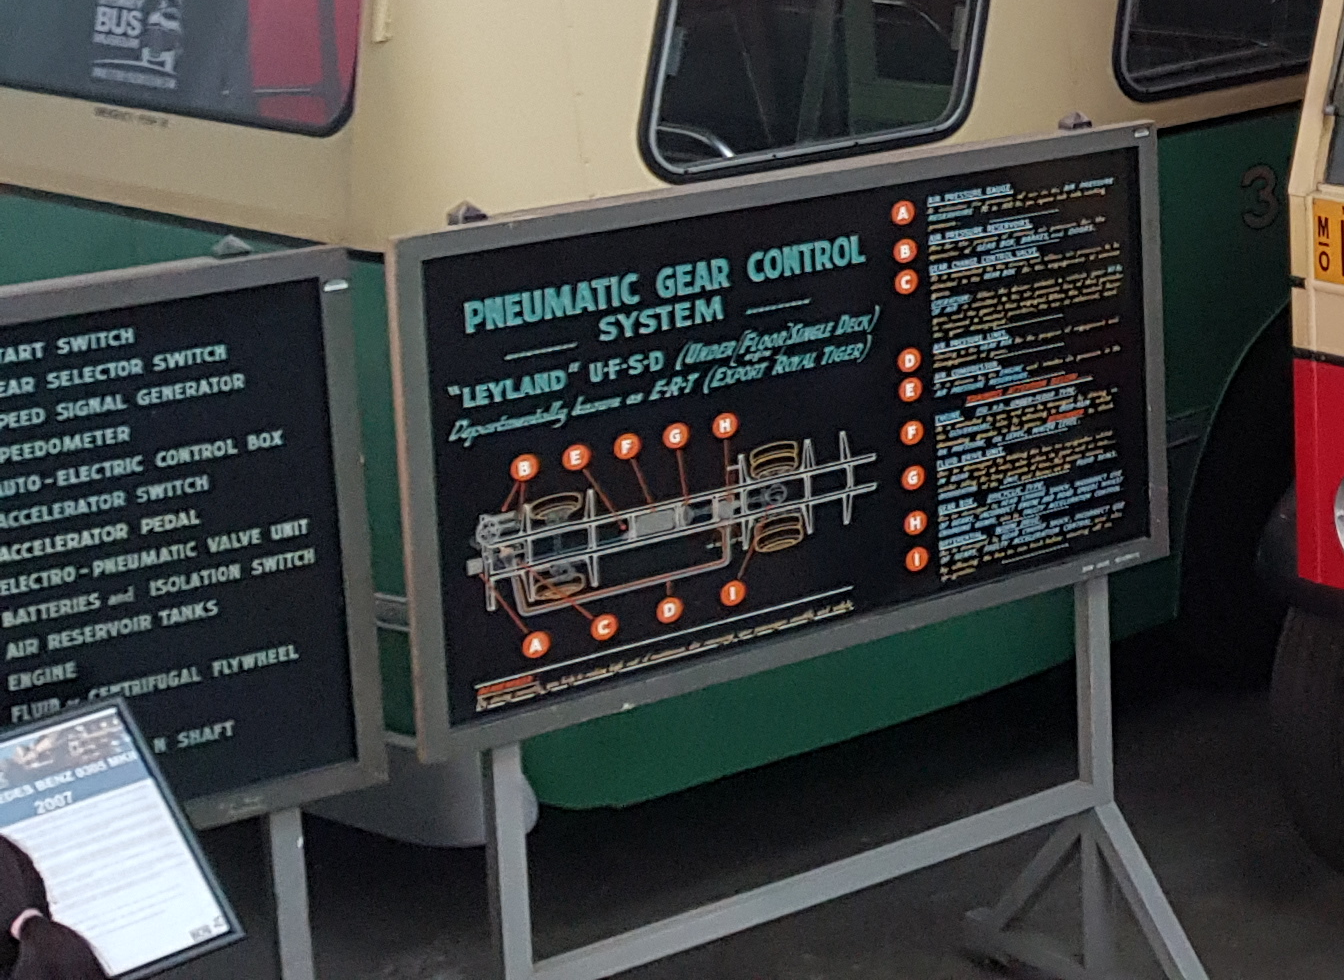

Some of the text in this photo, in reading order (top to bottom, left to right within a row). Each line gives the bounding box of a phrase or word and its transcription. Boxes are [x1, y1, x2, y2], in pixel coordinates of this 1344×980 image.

[94, 6, 143, 37] BUS
[897, 206, 909, 220] A
[900, 244, 911, 258] B
[463, 235, 867, 335] PNEUMATIC GEAR CONTROL
[901, 276, 911, 290] C
[598, 295, 724, 343] SYSTEM
[56, 327, 135, 356] SWITCH
[46, 358, 144, 391] SELECTOR
[152, 344, 228, 372] SWITCH
[905, 354, 915, 368] D
[55, 393, 128, 422] SIGNAL
[136, 372, 246, 407] GENERATOR
[447, 361, 582, 409] "LEYLAND"
[905, 383, 914, 397] E
[669, 428, 682, 443] G
[719, 419, 731, 433] H
[908, 425, 917, 439] F
[155, 438, 238, 469] CONTROL
[247, 429, 284, 450] BOX
[570, 450, 581, 465] E
[622, 440, 632, 454] F
[518, 461, 531, 476] B
[908, 471, 919, 484] G
[0, 474, 210, 529] ACCELERATOR SWITCH
[0, 509, 200, 562] ACCELERATOR PEDAL
[911, 517, 921, 530] H
[207, 528, 261, 553] VALVE
[270, 519, 309, 540] UNIT
[2, 548, 315, 628] BATTERIES and ISOLATION SWITCH
[663, 603, 676, 617] D
[6, 599, 218, 660] AIR RESERVOIR TANKS
[598, 620, 609, 634] C
[530, 638, 542, 652] A
[8, 661, 78, 692] ENGINE
[11, 697, 60, 722] FLUID
[212, 644, 300, 678] FLYWHEEL
[177, 720, 235, 749] SHAFT
[34, 791, 73, 815] 2007
